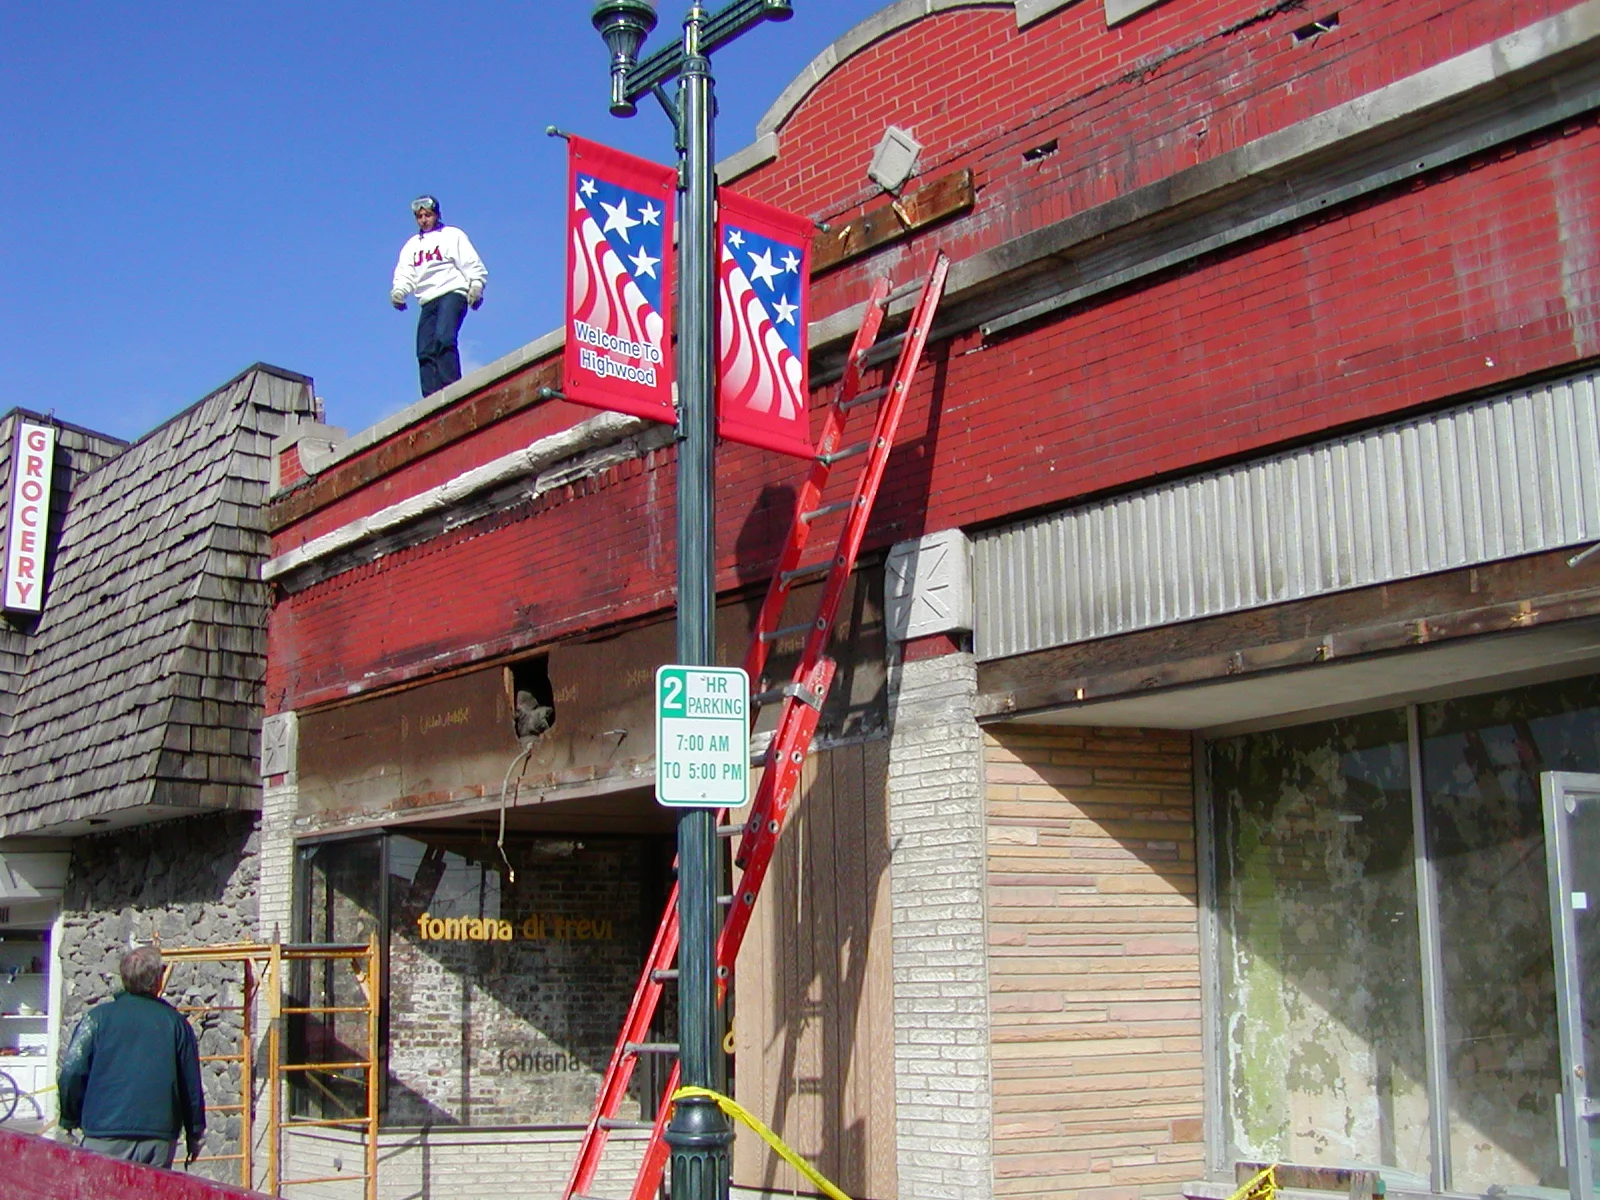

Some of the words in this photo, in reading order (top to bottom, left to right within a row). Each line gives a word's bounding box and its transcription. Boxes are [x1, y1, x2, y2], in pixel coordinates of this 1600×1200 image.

[575, 321, 640, 357] Welcome
[643, 343, 660, 362] To
[581, 349, 655, 385] Highwood
[15, 430, 46, 604] GROCERY
[663, 676, 683, 710] 2
[706, 677, 728, 694] HR
[688, 697, 742, 715] PARKING
[676, 734, 704, 751] 7:00
[709, 735, 729, 752] AM
[664, 762, 681, 779] TO
[689, 763, 716, 780] 5:00
[723, 764, 742, 780] PM
[417, 912, 513, 941] fontana
[523, 913, 546, 940] di
